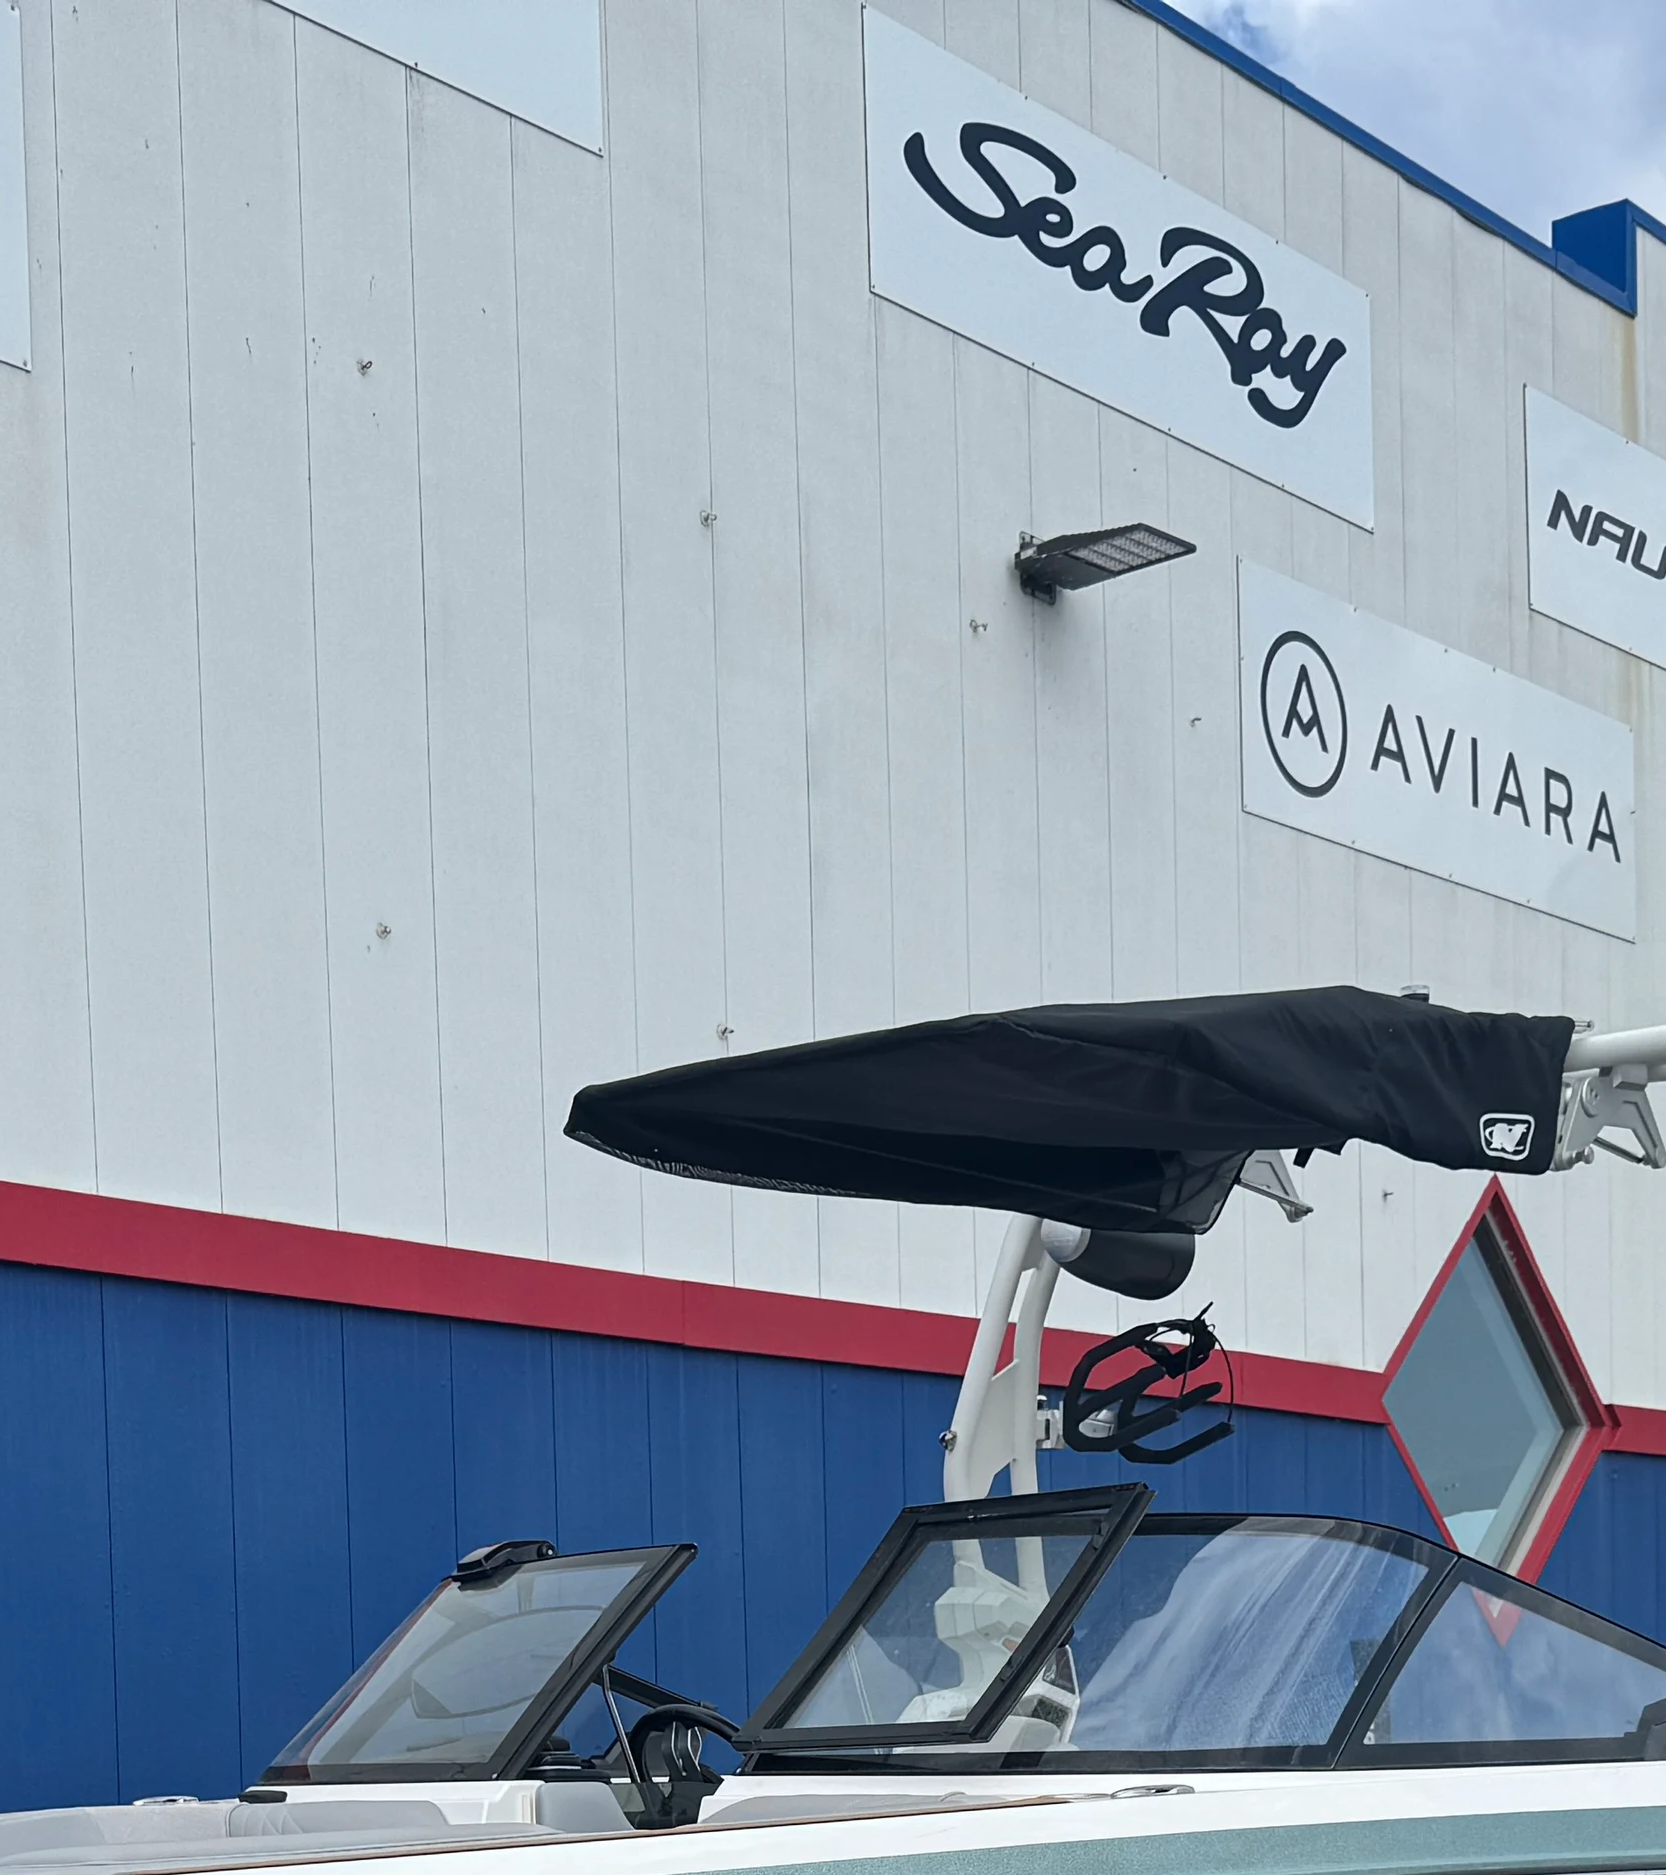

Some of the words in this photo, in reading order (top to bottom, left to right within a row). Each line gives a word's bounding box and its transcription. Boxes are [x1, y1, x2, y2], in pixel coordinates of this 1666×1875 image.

[904, 122, 1154, 303] Sea
[1140, 226, 1347, 429] Ray
[1370, 703, 1622, 864] AVIARA
